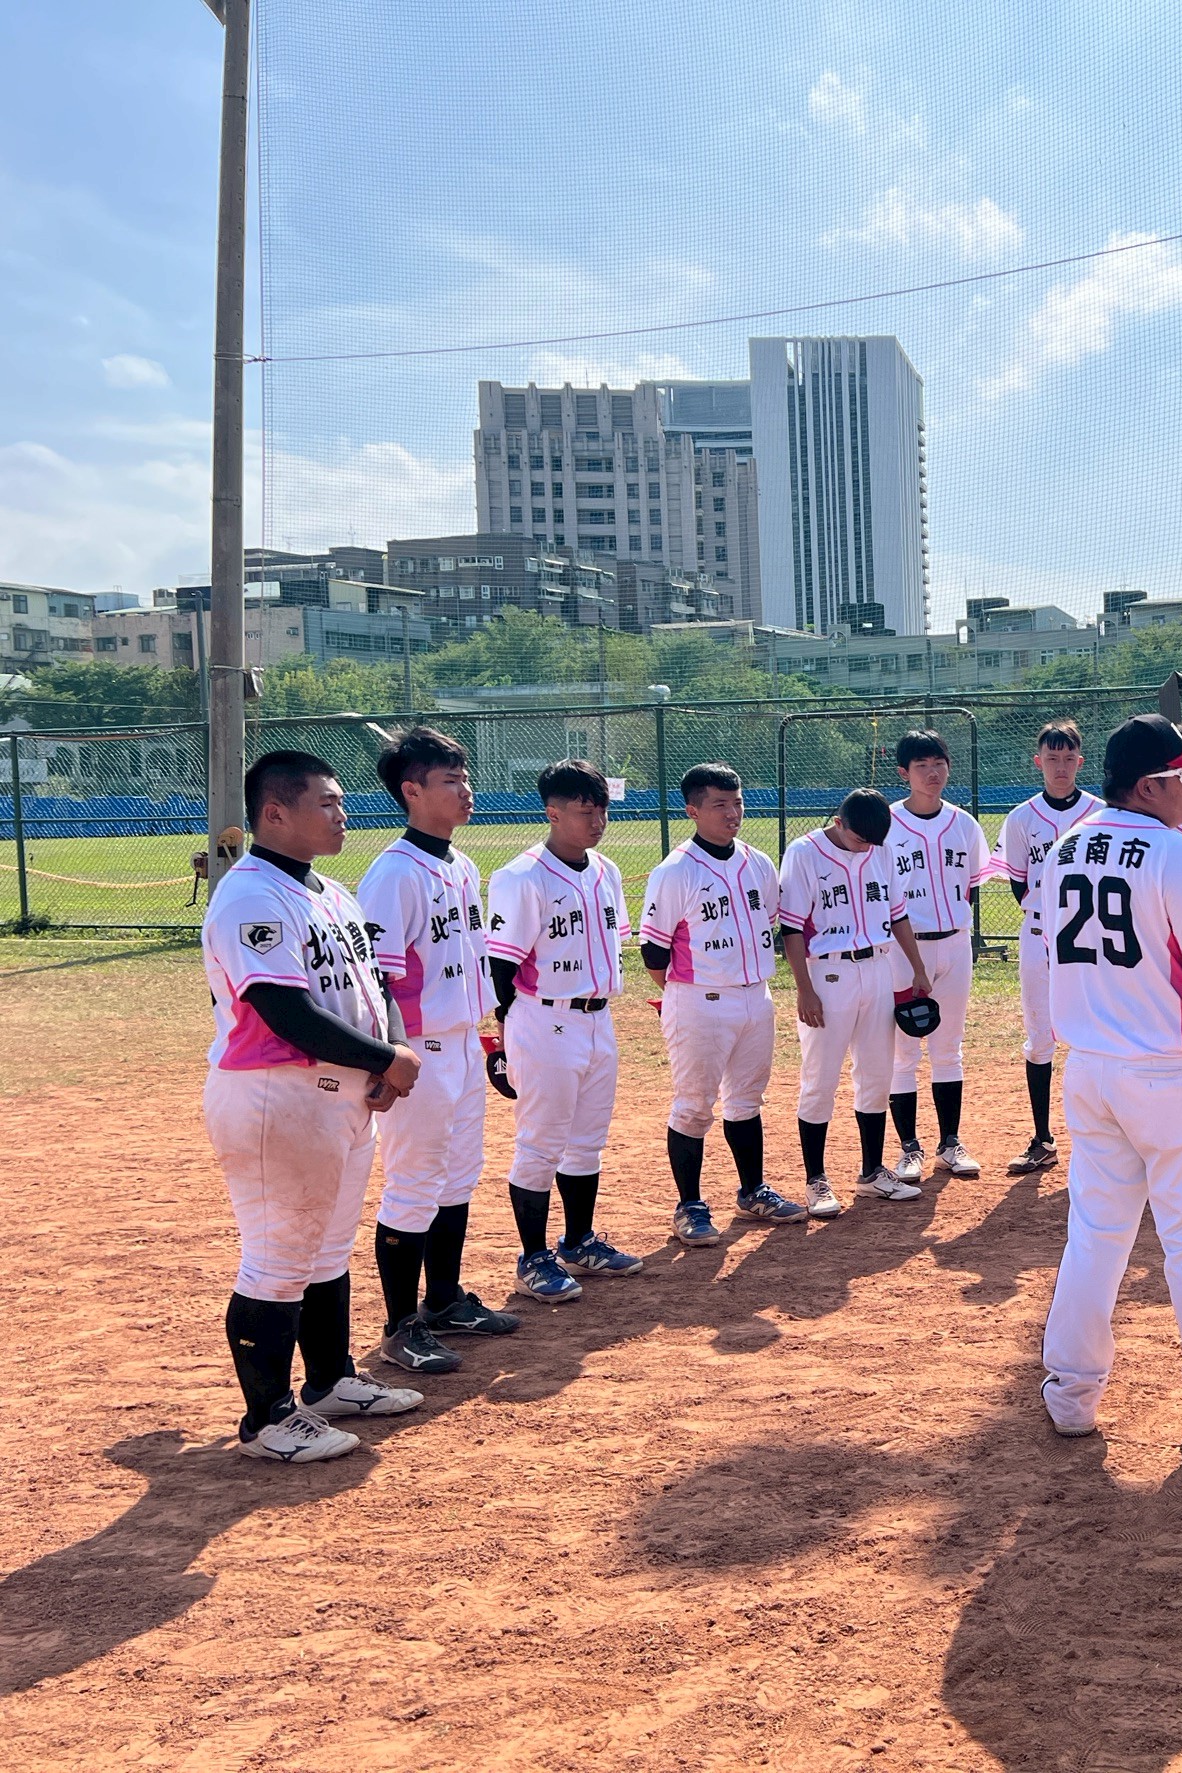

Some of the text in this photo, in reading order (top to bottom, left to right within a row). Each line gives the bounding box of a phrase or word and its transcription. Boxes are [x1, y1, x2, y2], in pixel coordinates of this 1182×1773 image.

[896, 848, 968, 876] 北門農工
[1057, 832, 1151, 869] 臺南市
[1056, 873, 1143, 969] 29
[704, 936, 734, 952] PMAI
[553, 960, 583, 973] PMAI
